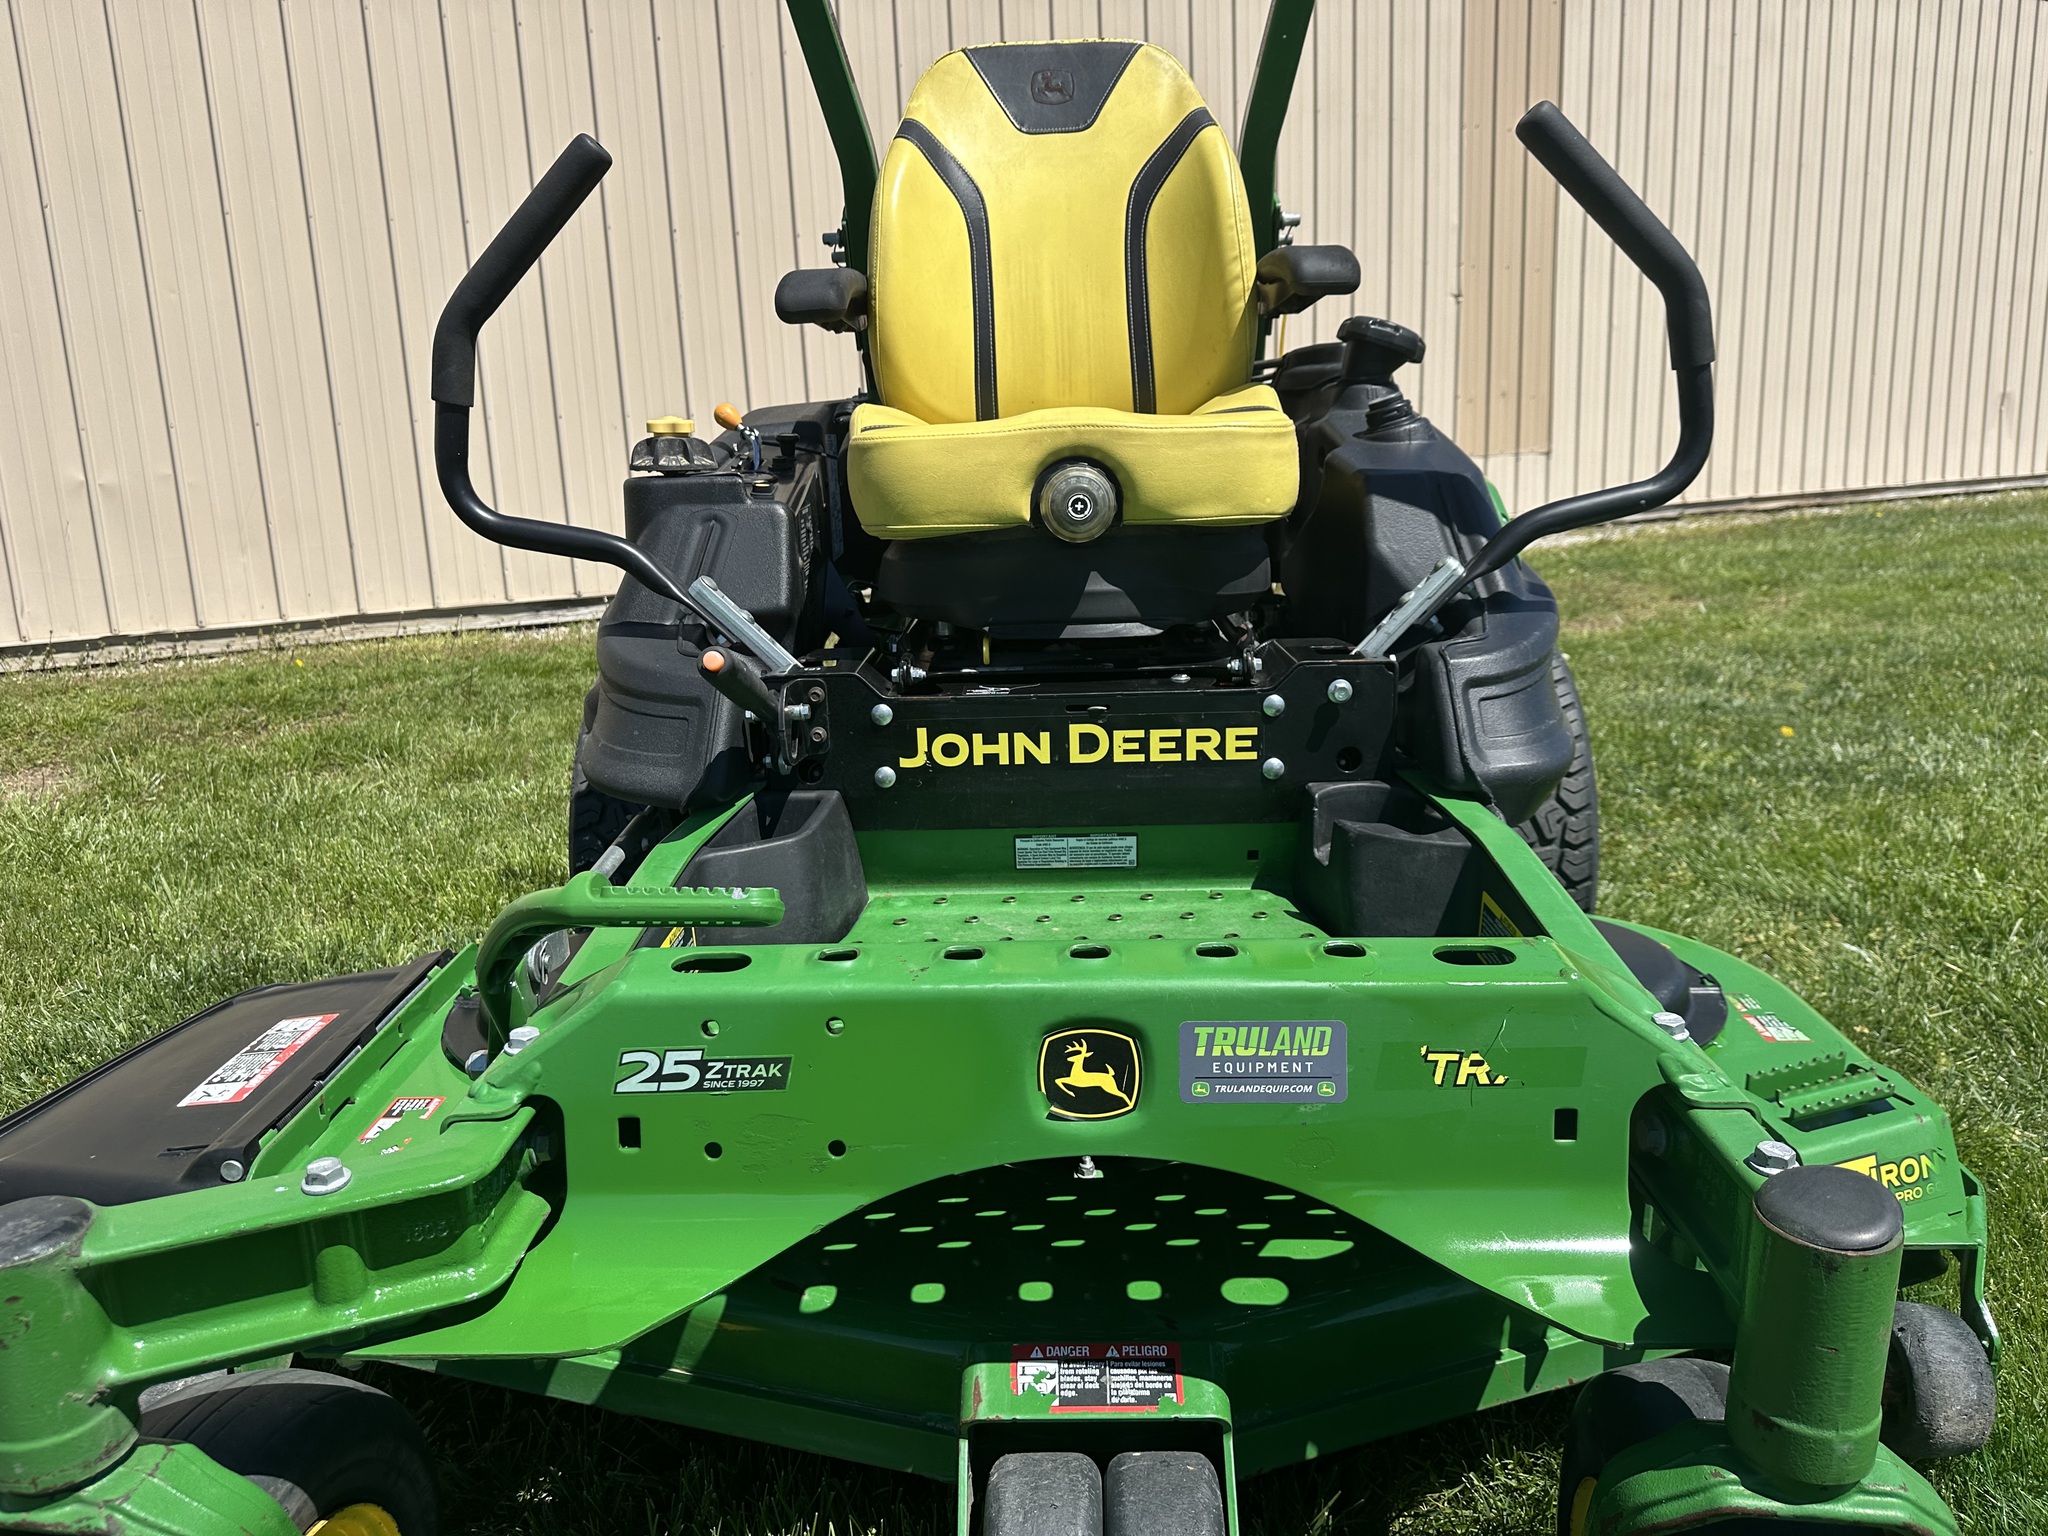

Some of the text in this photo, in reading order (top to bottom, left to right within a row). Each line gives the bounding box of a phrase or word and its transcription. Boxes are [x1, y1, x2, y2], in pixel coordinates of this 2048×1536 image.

[899, 723, 1259, 769] JOHN DEERE
[1193, 1026, 1333, 1057] TRULAND
[615, 1049, 704, 1093] 25
[704, 1061, 784, 1079] ZTRAK
[1212, 1061, 1315, 1073] EQUIPMENT
[702, 1079, 765, 1089] SINCE 1997
[1214, 1084, 1314, 1094] TRULANDEQUIP.COM
[1046, 1345, 1090, 1357] DANGER
[1121, 1344, 1168, 1357] PELIGRO
